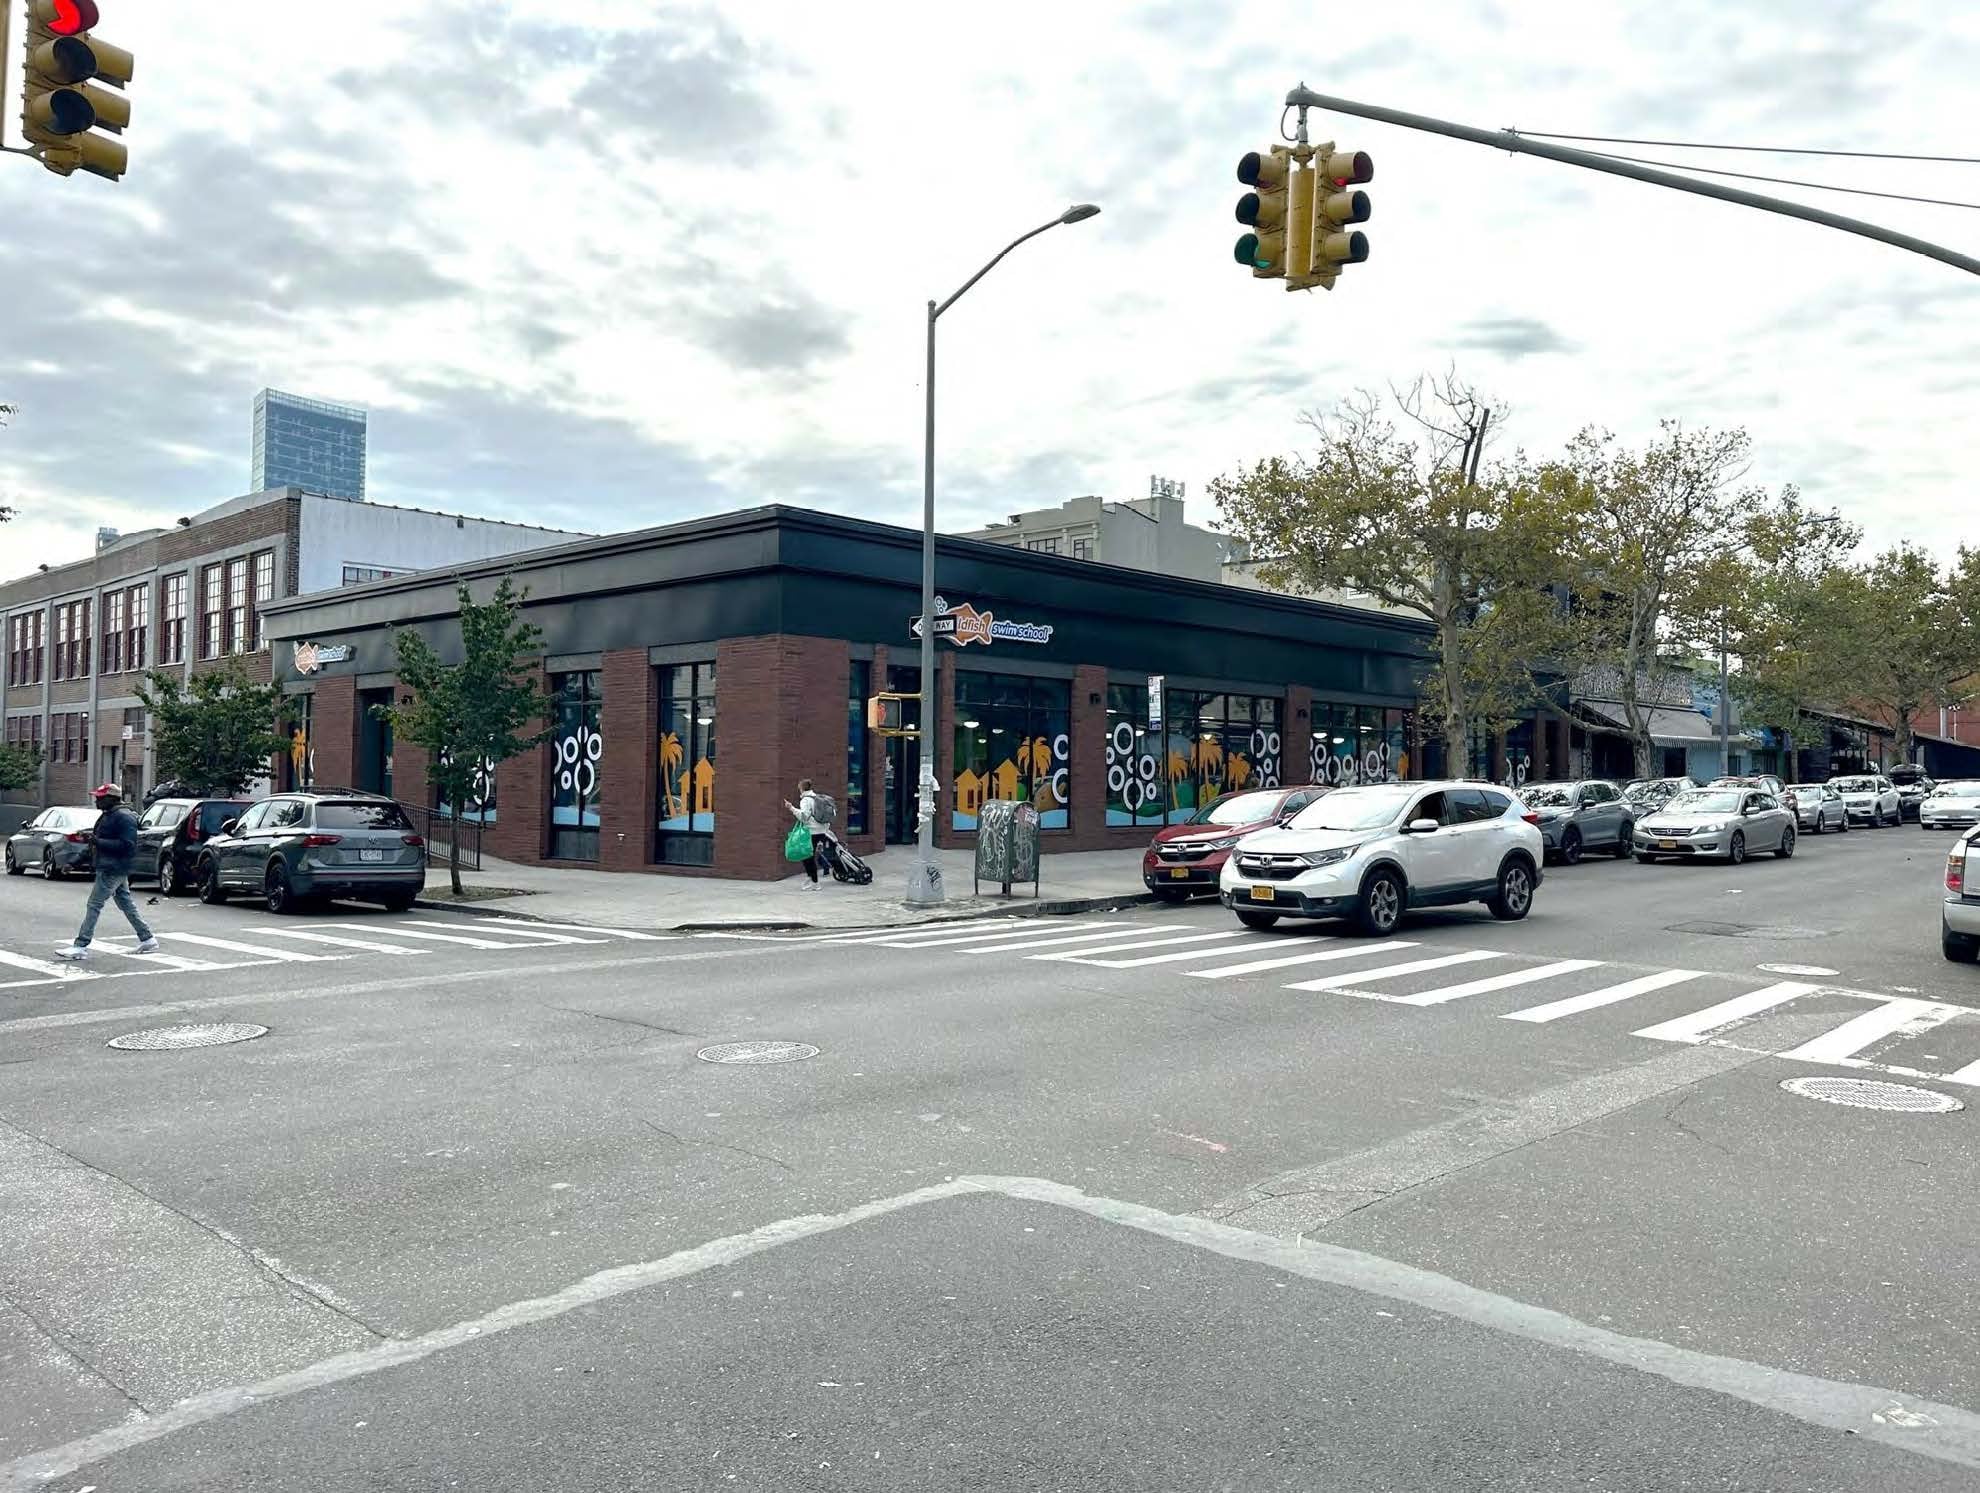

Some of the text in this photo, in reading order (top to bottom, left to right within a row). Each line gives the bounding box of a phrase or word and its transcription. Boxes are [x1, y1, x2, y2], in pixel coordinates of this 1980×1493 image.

[957, 617, 1048, 640] ldfish swim school
